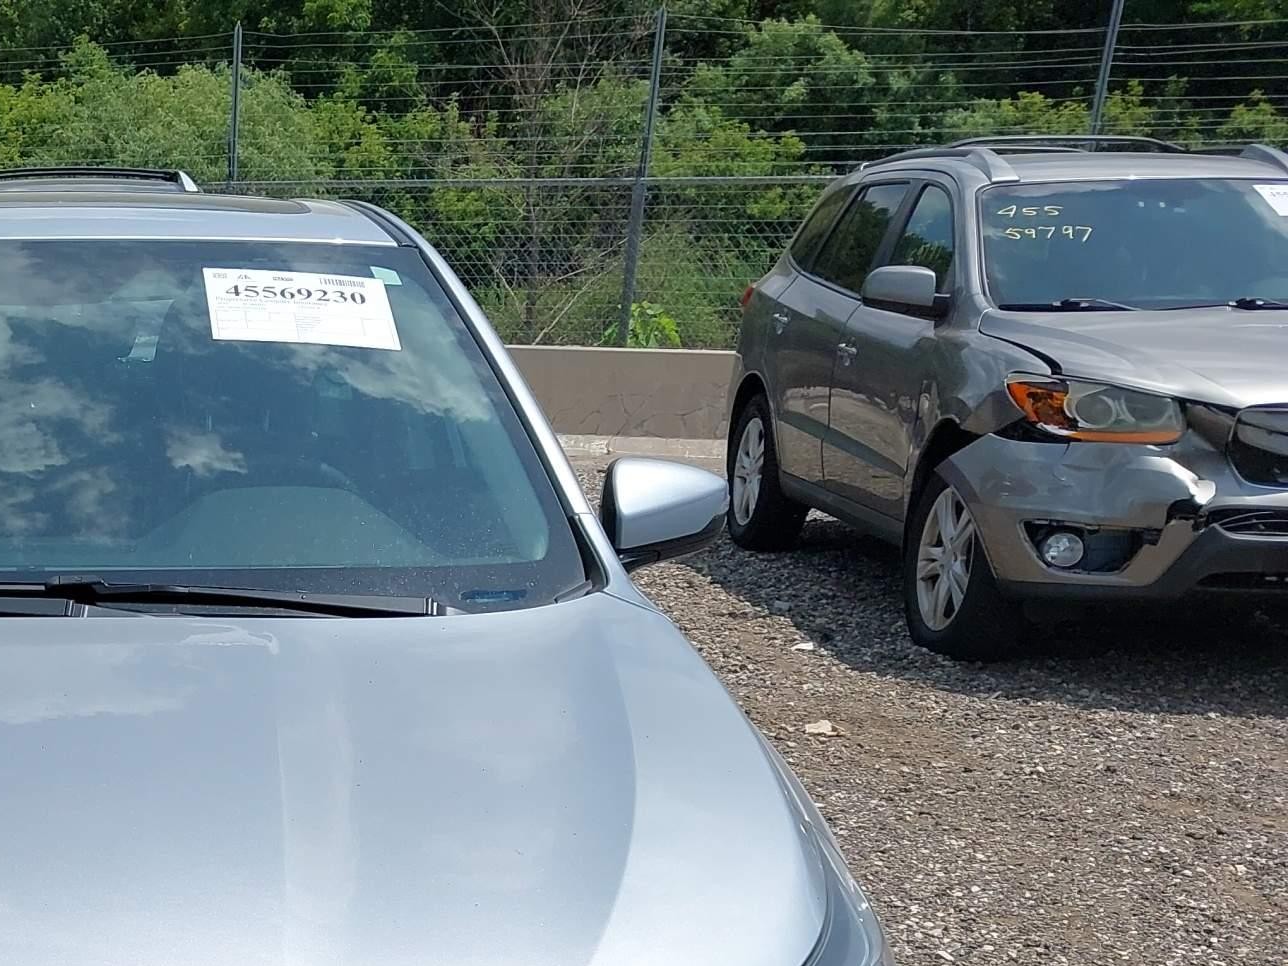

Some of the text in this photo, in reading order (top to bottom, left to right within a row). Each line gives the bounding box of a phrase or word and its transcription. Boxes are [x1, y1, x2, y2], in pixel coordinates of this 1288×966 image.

[996, 205, 1064, 218] 455
[1004, 225, 1093, 242] 59797
[225, 284, 366, 305] 45569230
